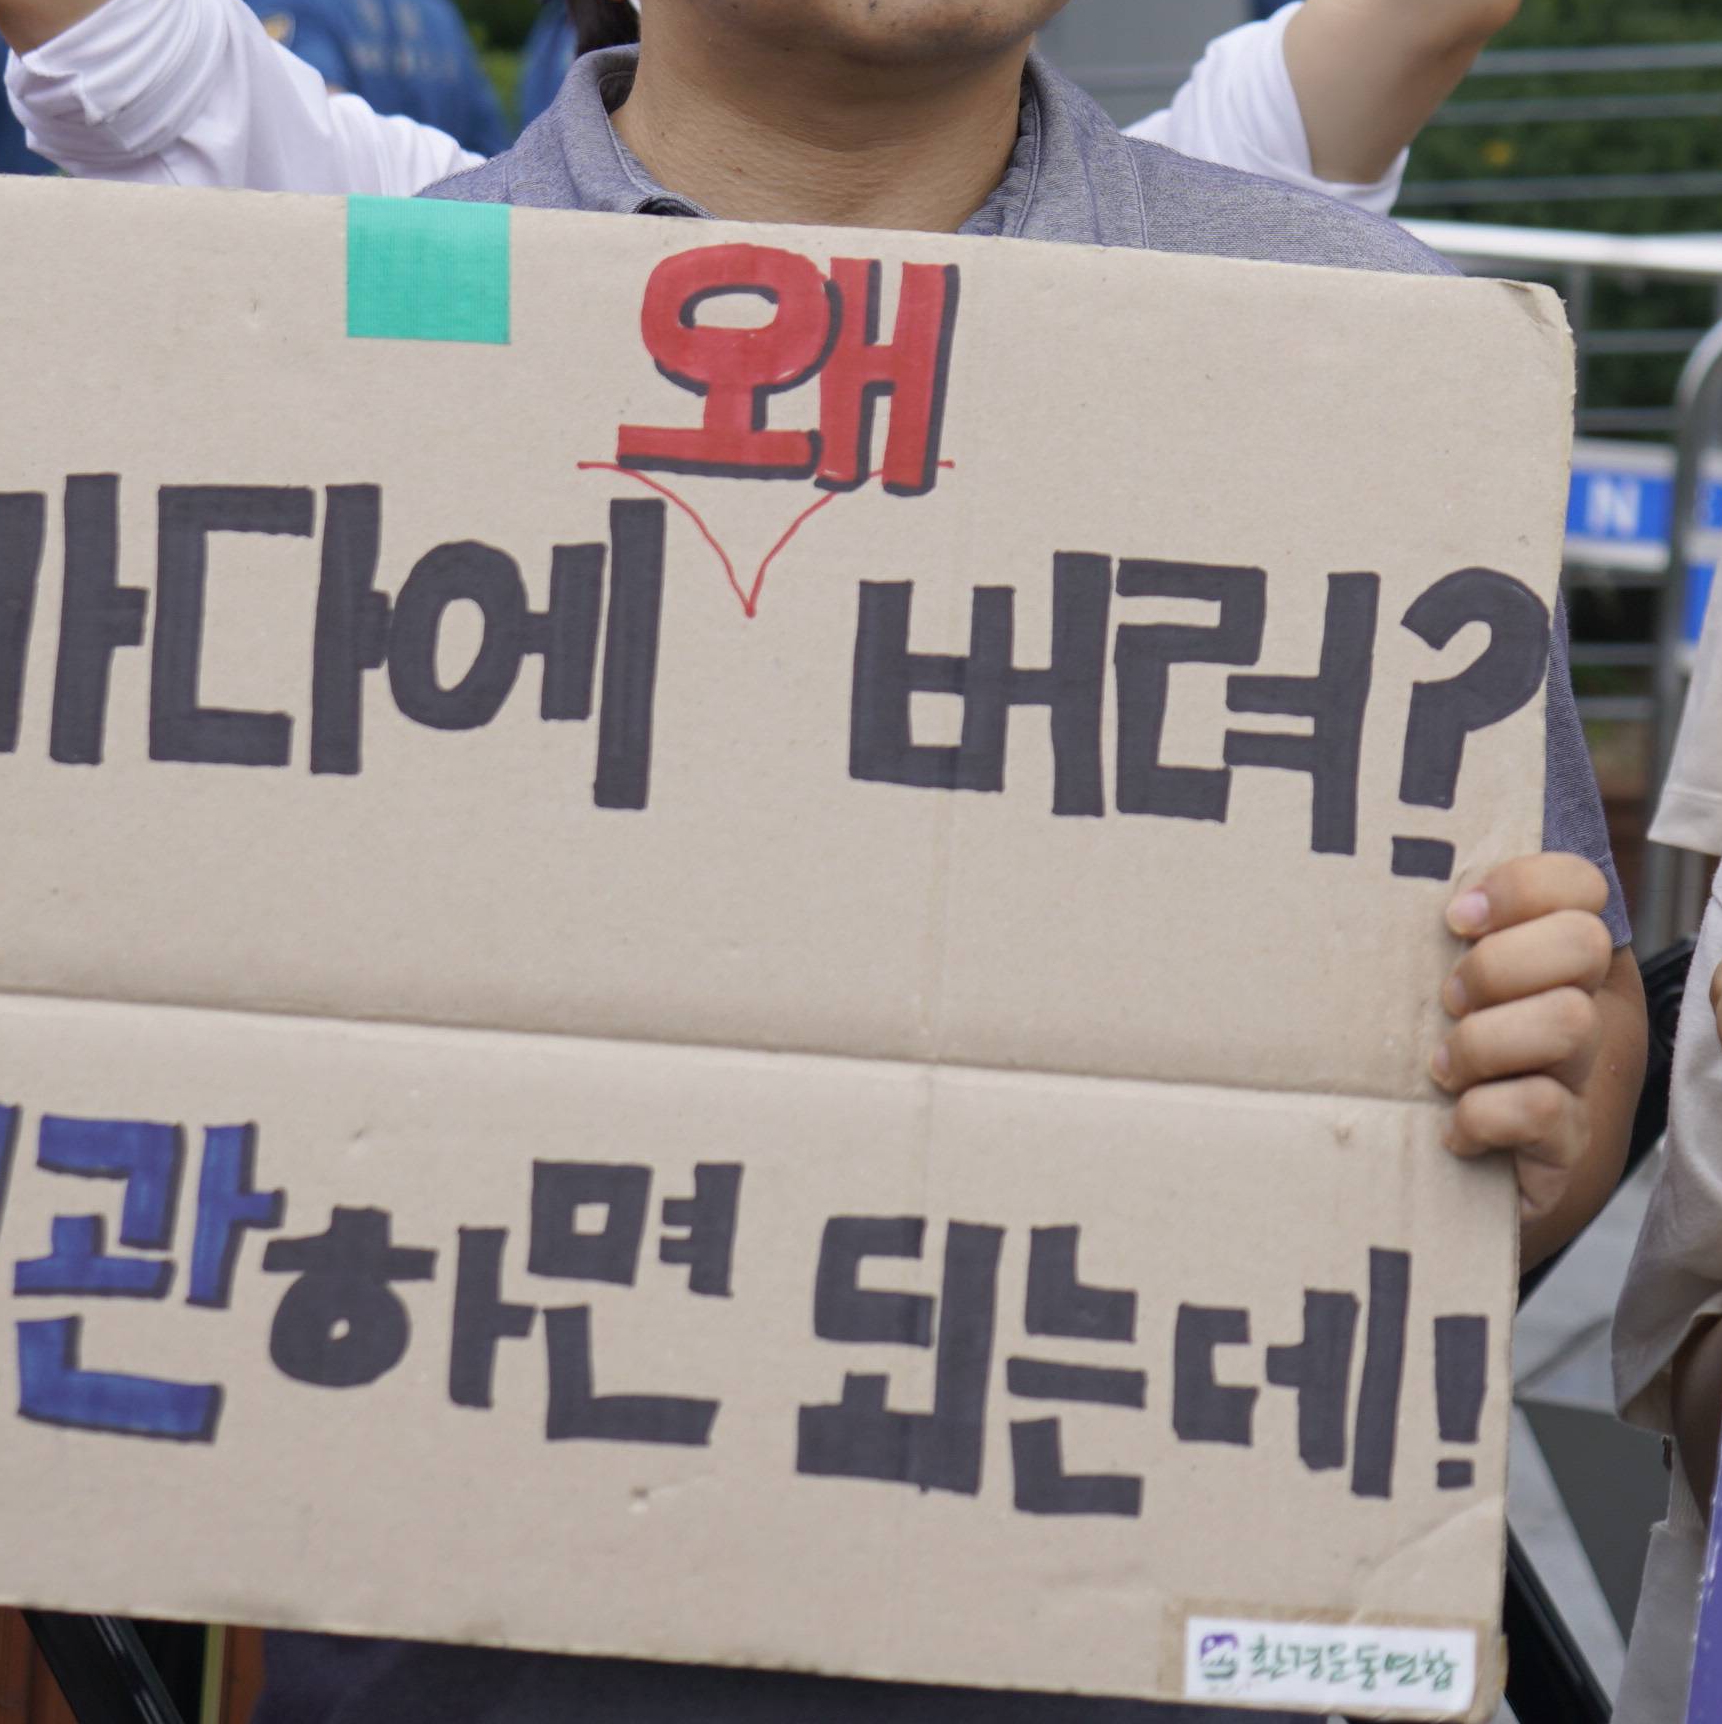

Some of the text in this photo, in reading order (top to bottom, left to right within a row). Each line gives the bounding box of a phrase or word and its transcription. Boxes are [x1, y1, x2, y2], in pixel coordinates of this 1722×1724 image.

[617, 242, 963, 497] 왜
[848, 550, 1551, 882] 버려?
[795, 1214, 1490, 1518] 되는데!
[1248, 1635, 1460, 1694] 환경운동연합
